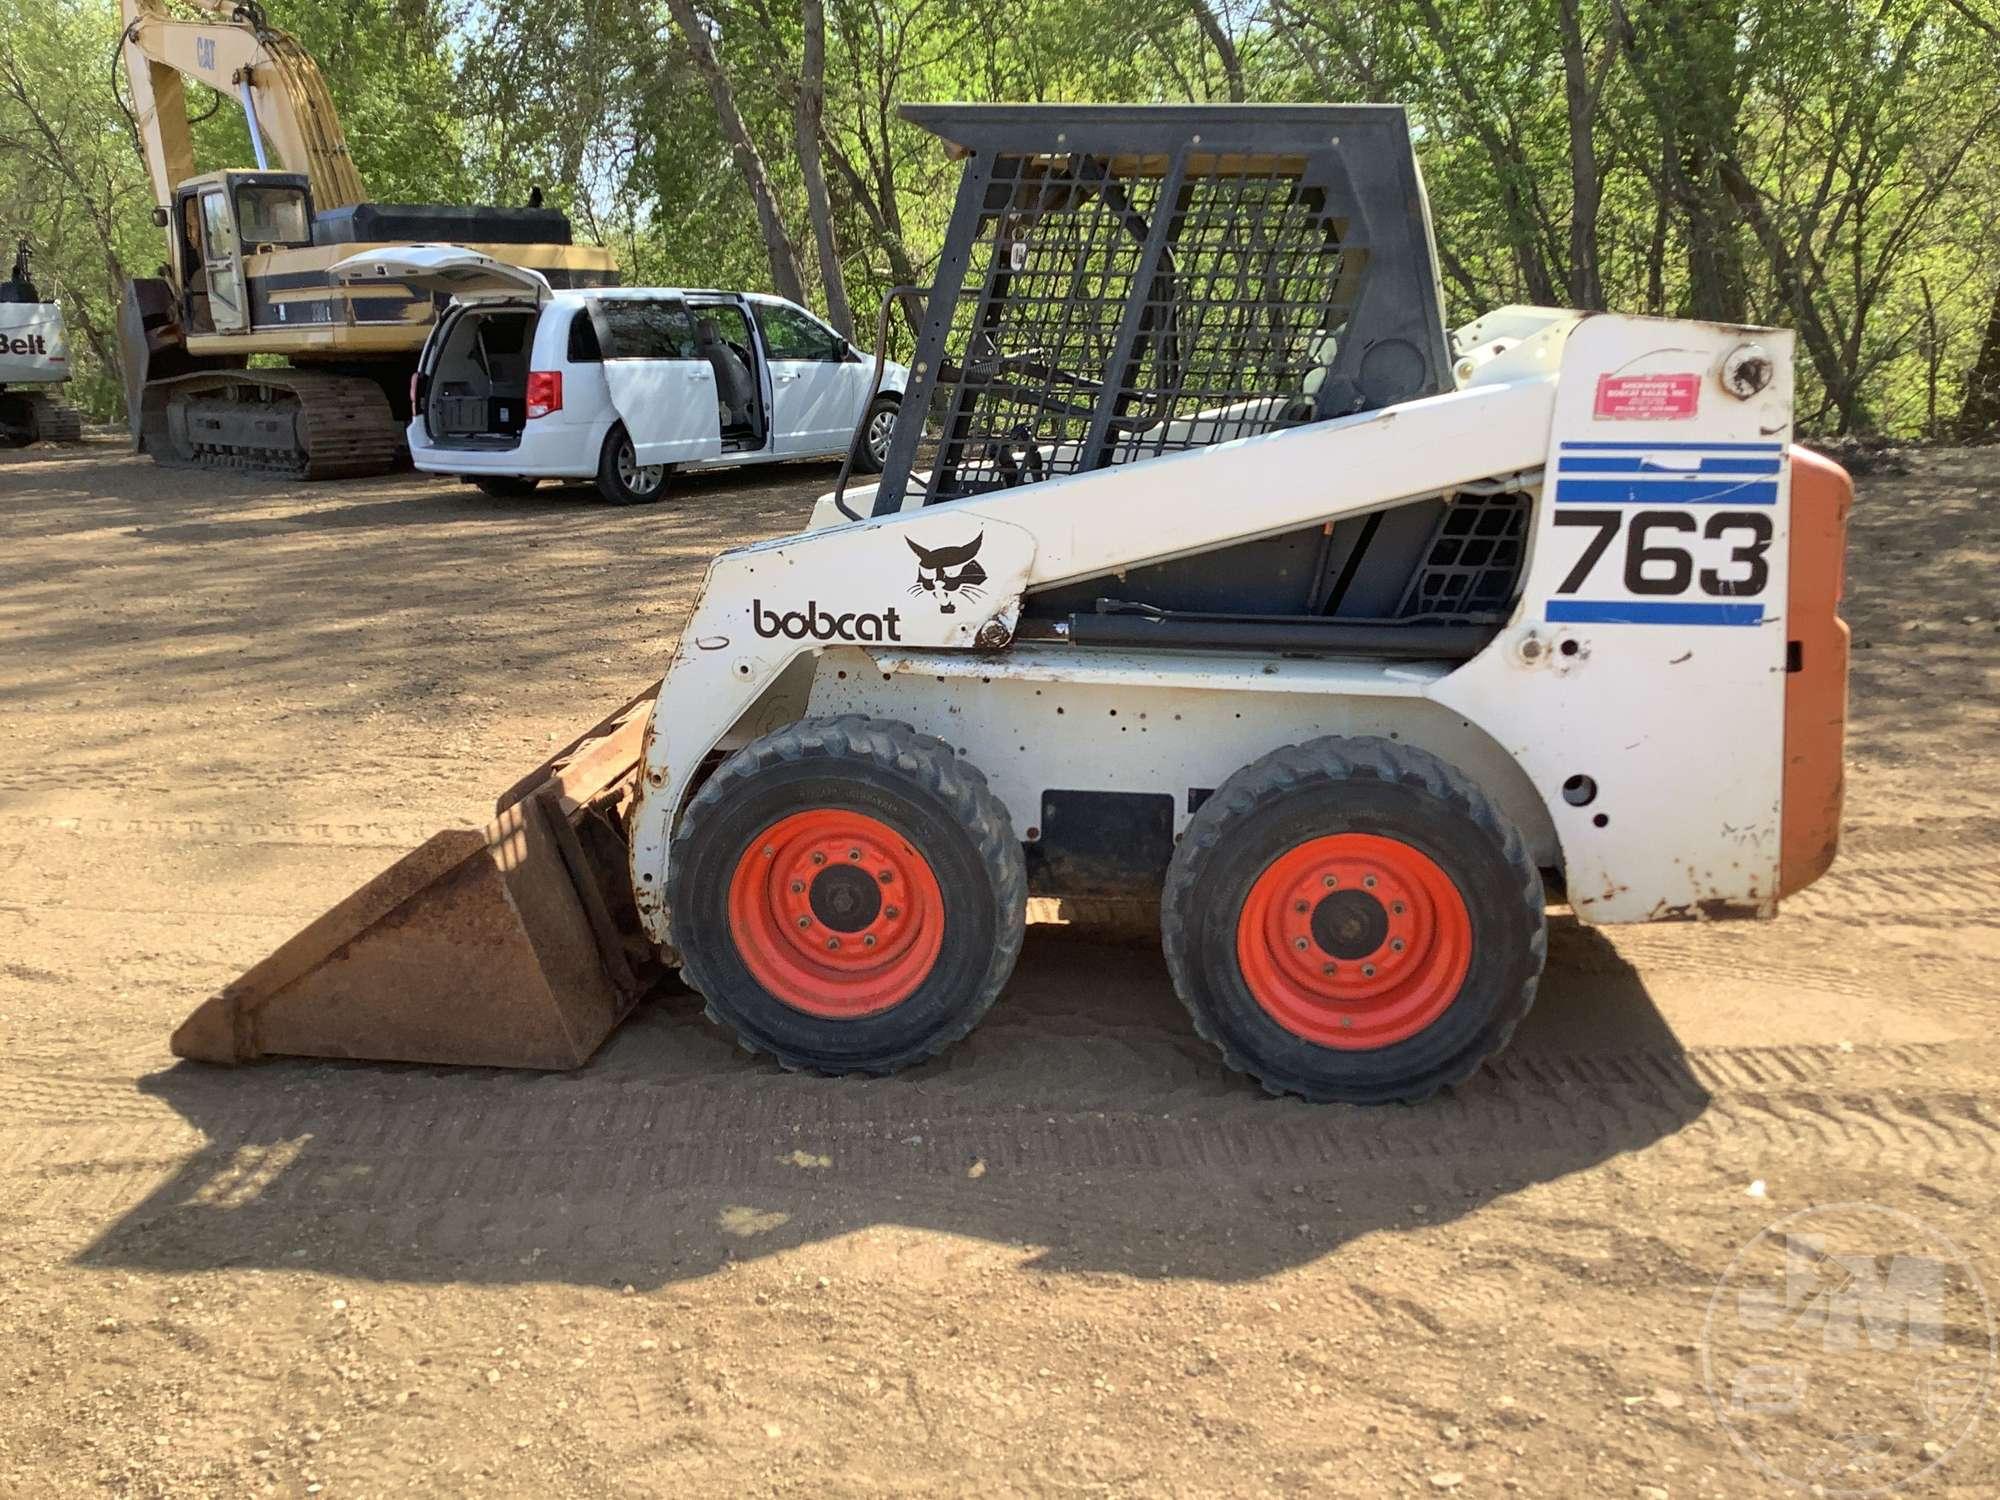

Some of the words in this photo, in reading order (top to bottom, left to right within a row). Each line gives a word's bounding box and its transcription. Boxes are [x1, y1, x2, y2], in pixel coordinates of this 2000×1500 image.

[197, 36, 216, 70] CAT
[1553, 509, 1773, 597] 763
[753, 598, 901, 642] bobcat
